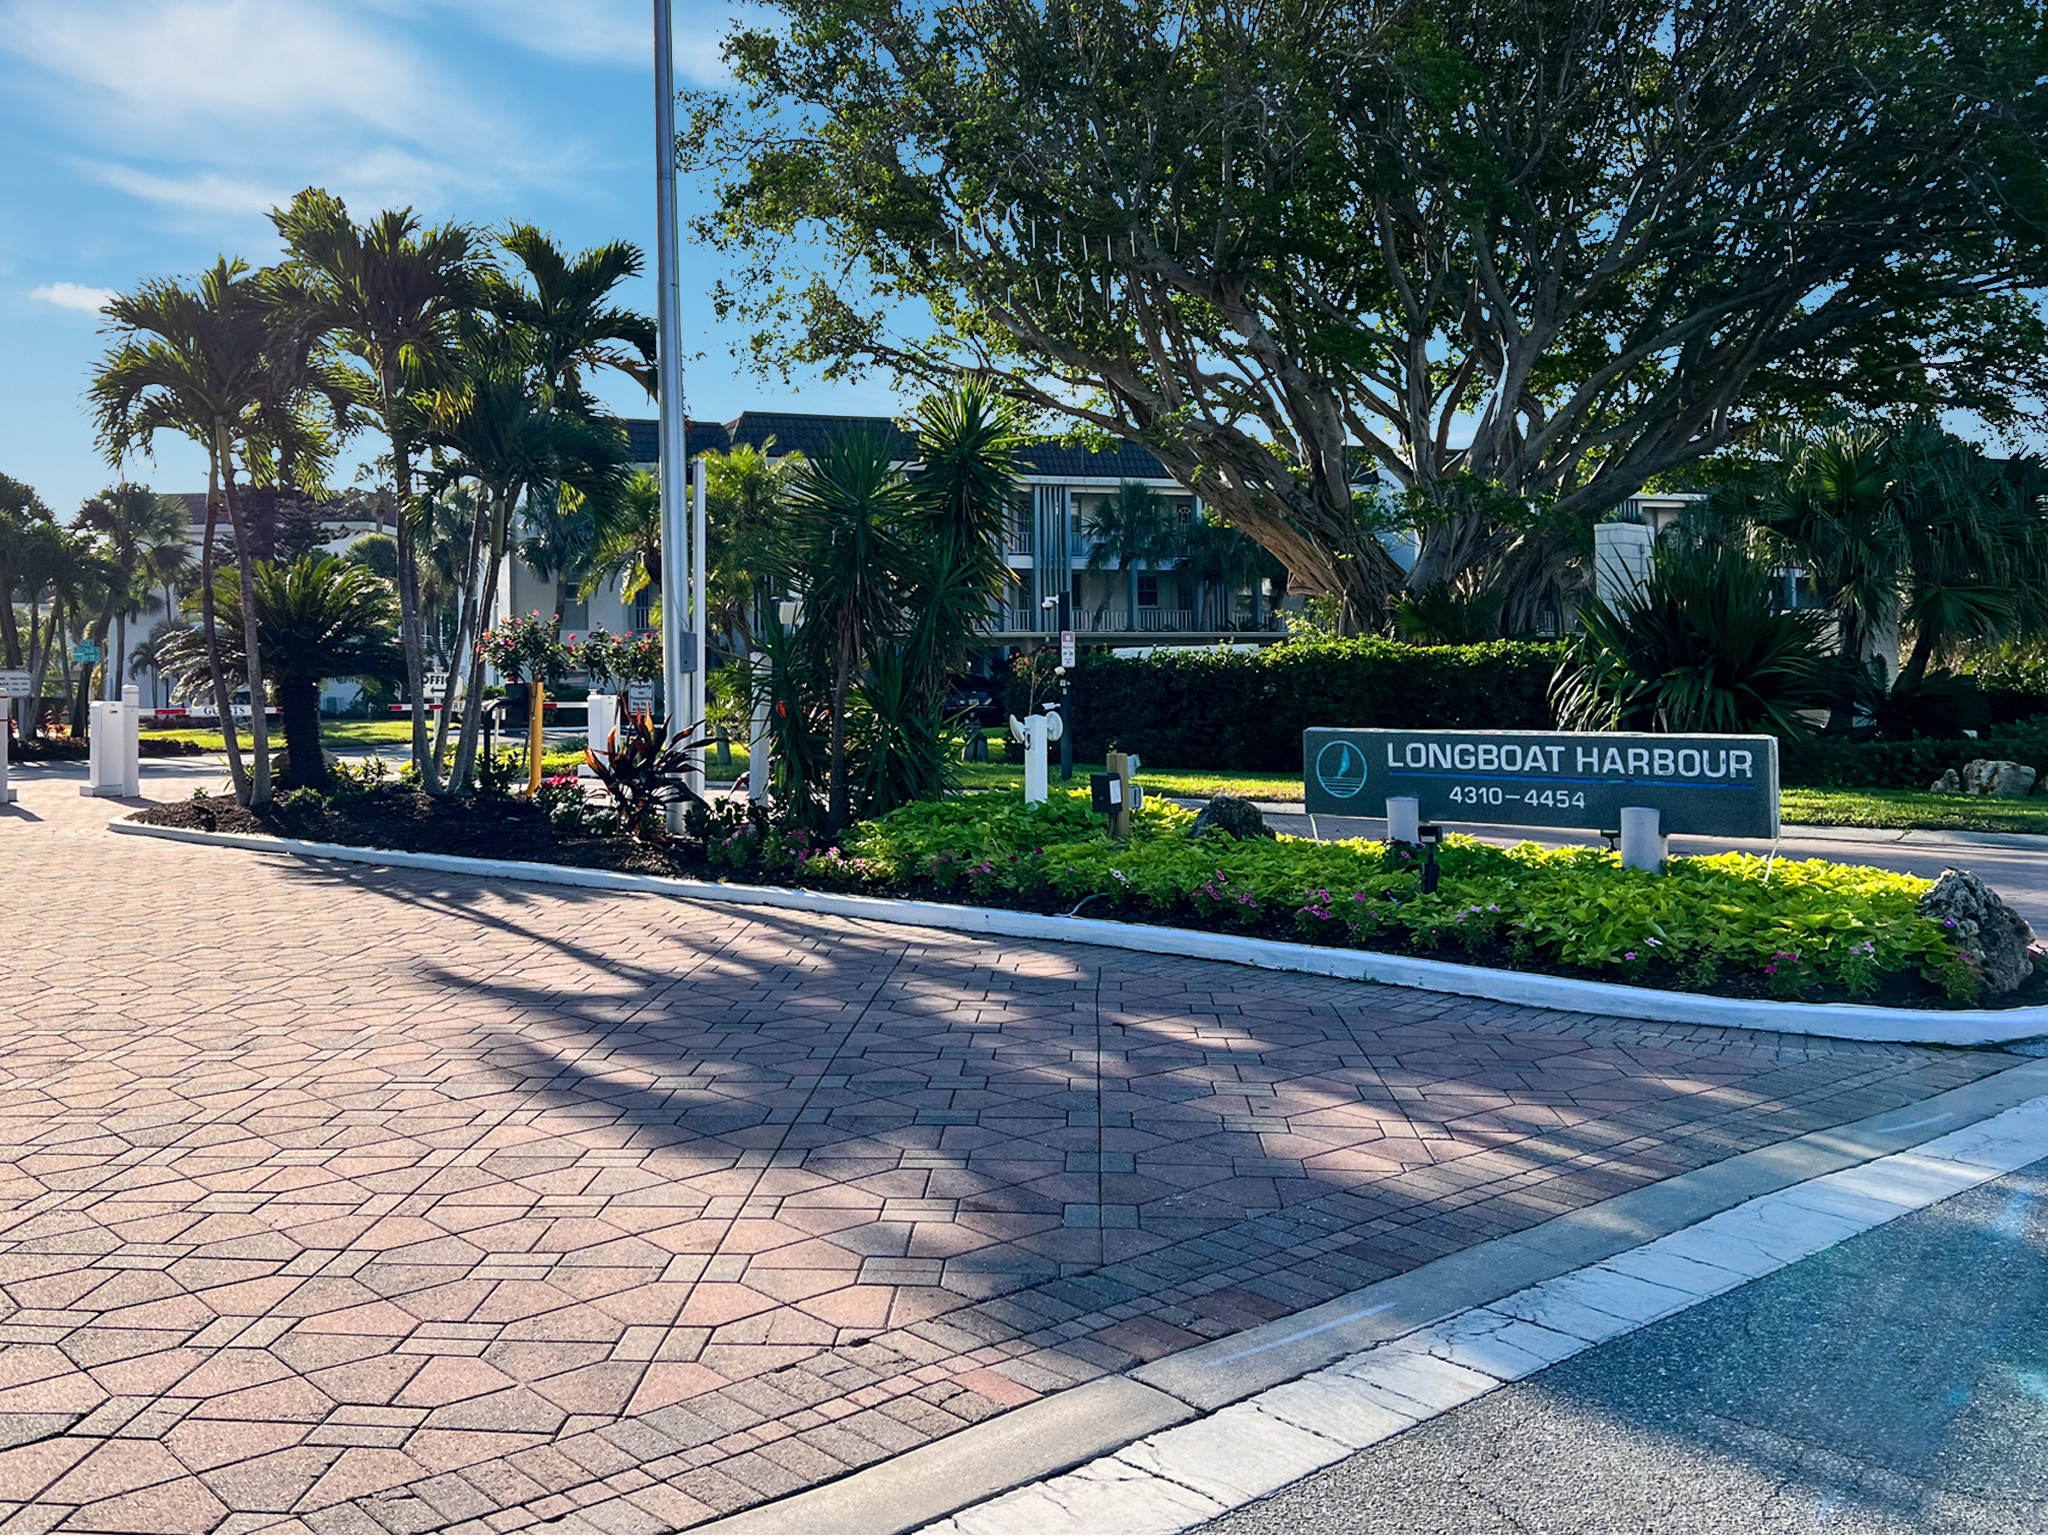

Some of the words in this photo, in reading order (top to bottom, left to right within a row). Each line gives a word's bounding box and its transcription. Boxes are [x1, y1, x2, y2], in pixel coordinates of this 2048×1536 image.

[422, 675, 448, 685] OFFI
[203, 706, 246, 716] GUTS
[1387, 742, 1566, 773] LONGBOAT
[1576, 746, 1753, 779] HARBOUR
[1449, 785, 1586, 810] 4310-4454
